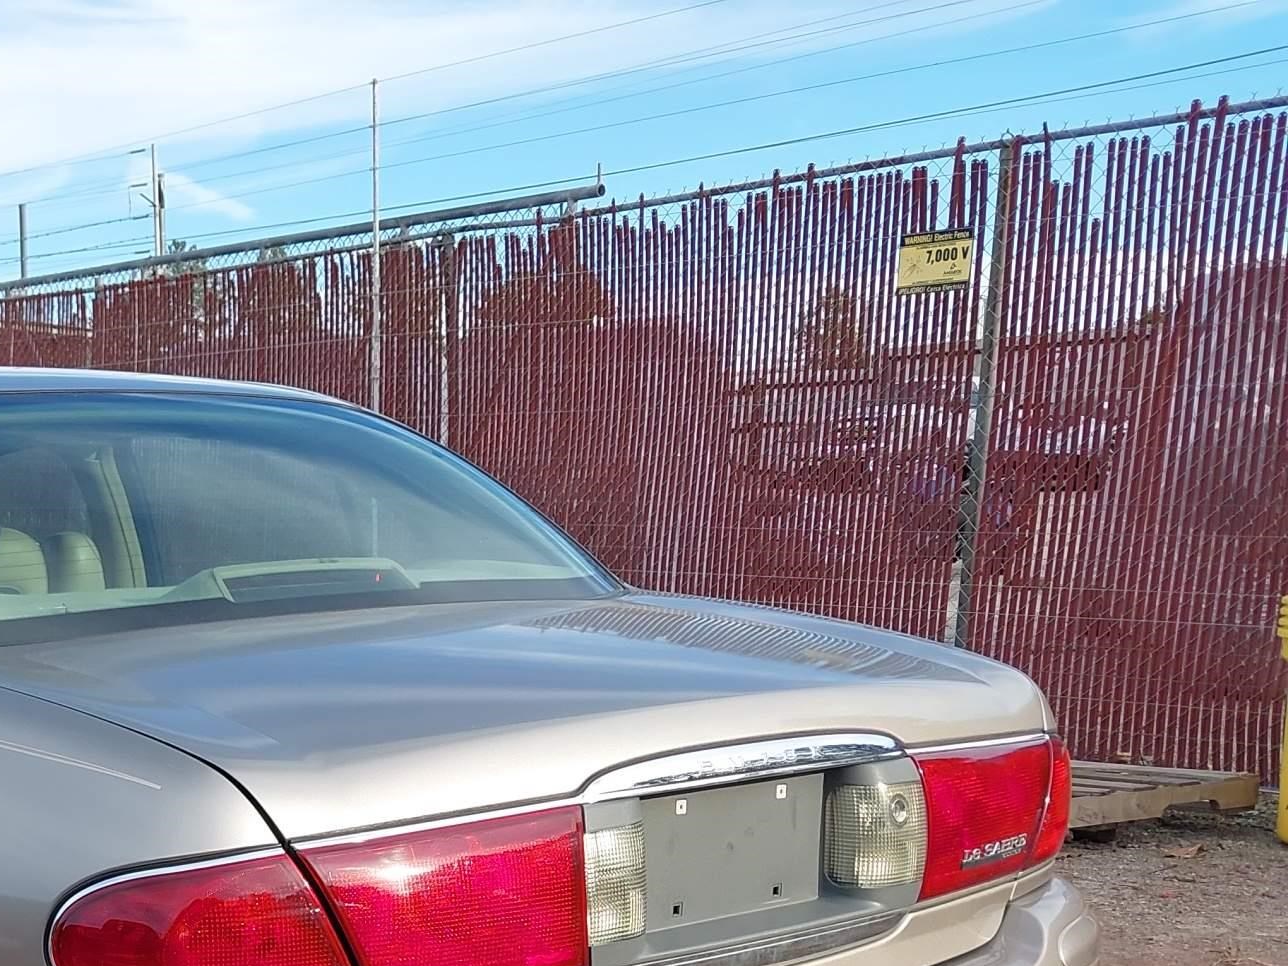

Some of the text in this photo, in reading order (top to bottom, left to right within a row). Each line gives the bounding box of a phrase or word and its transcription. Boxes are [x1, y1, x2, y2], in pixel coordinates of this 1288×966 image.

[904, 230, 970, 245] WARNING! Electric Fence
[926, 247, 958, 264] 7,000
[962, 245, 970, 259] V
